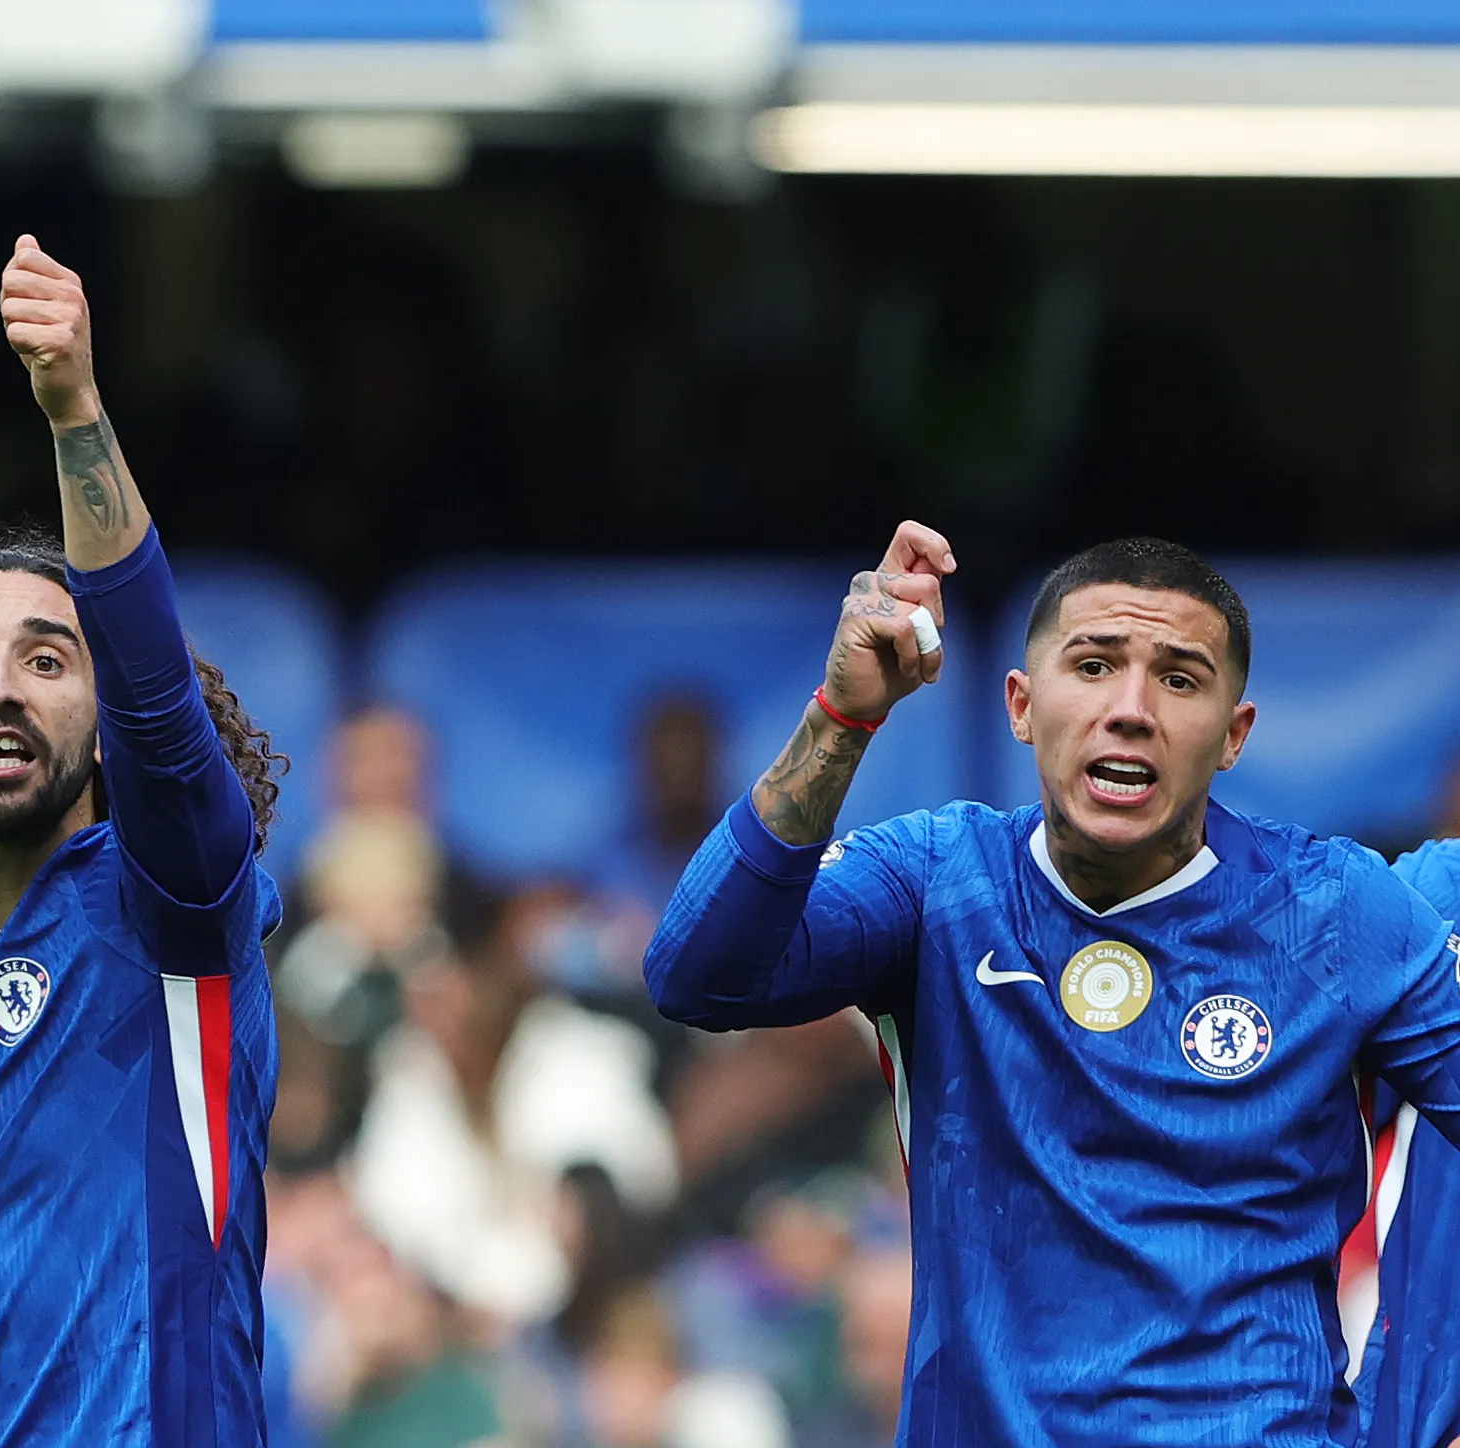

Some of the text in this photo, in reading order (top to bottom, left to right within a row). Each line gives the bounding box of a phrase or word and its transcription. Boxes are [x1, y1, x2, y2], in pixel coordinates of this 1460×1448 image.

[1067, 948, 1144, 998] WORLD CHAMPIONS
[1084, 1010, 1119, 1024] FIFA
[1198, 998, 1257, 1019] CHELSEA
